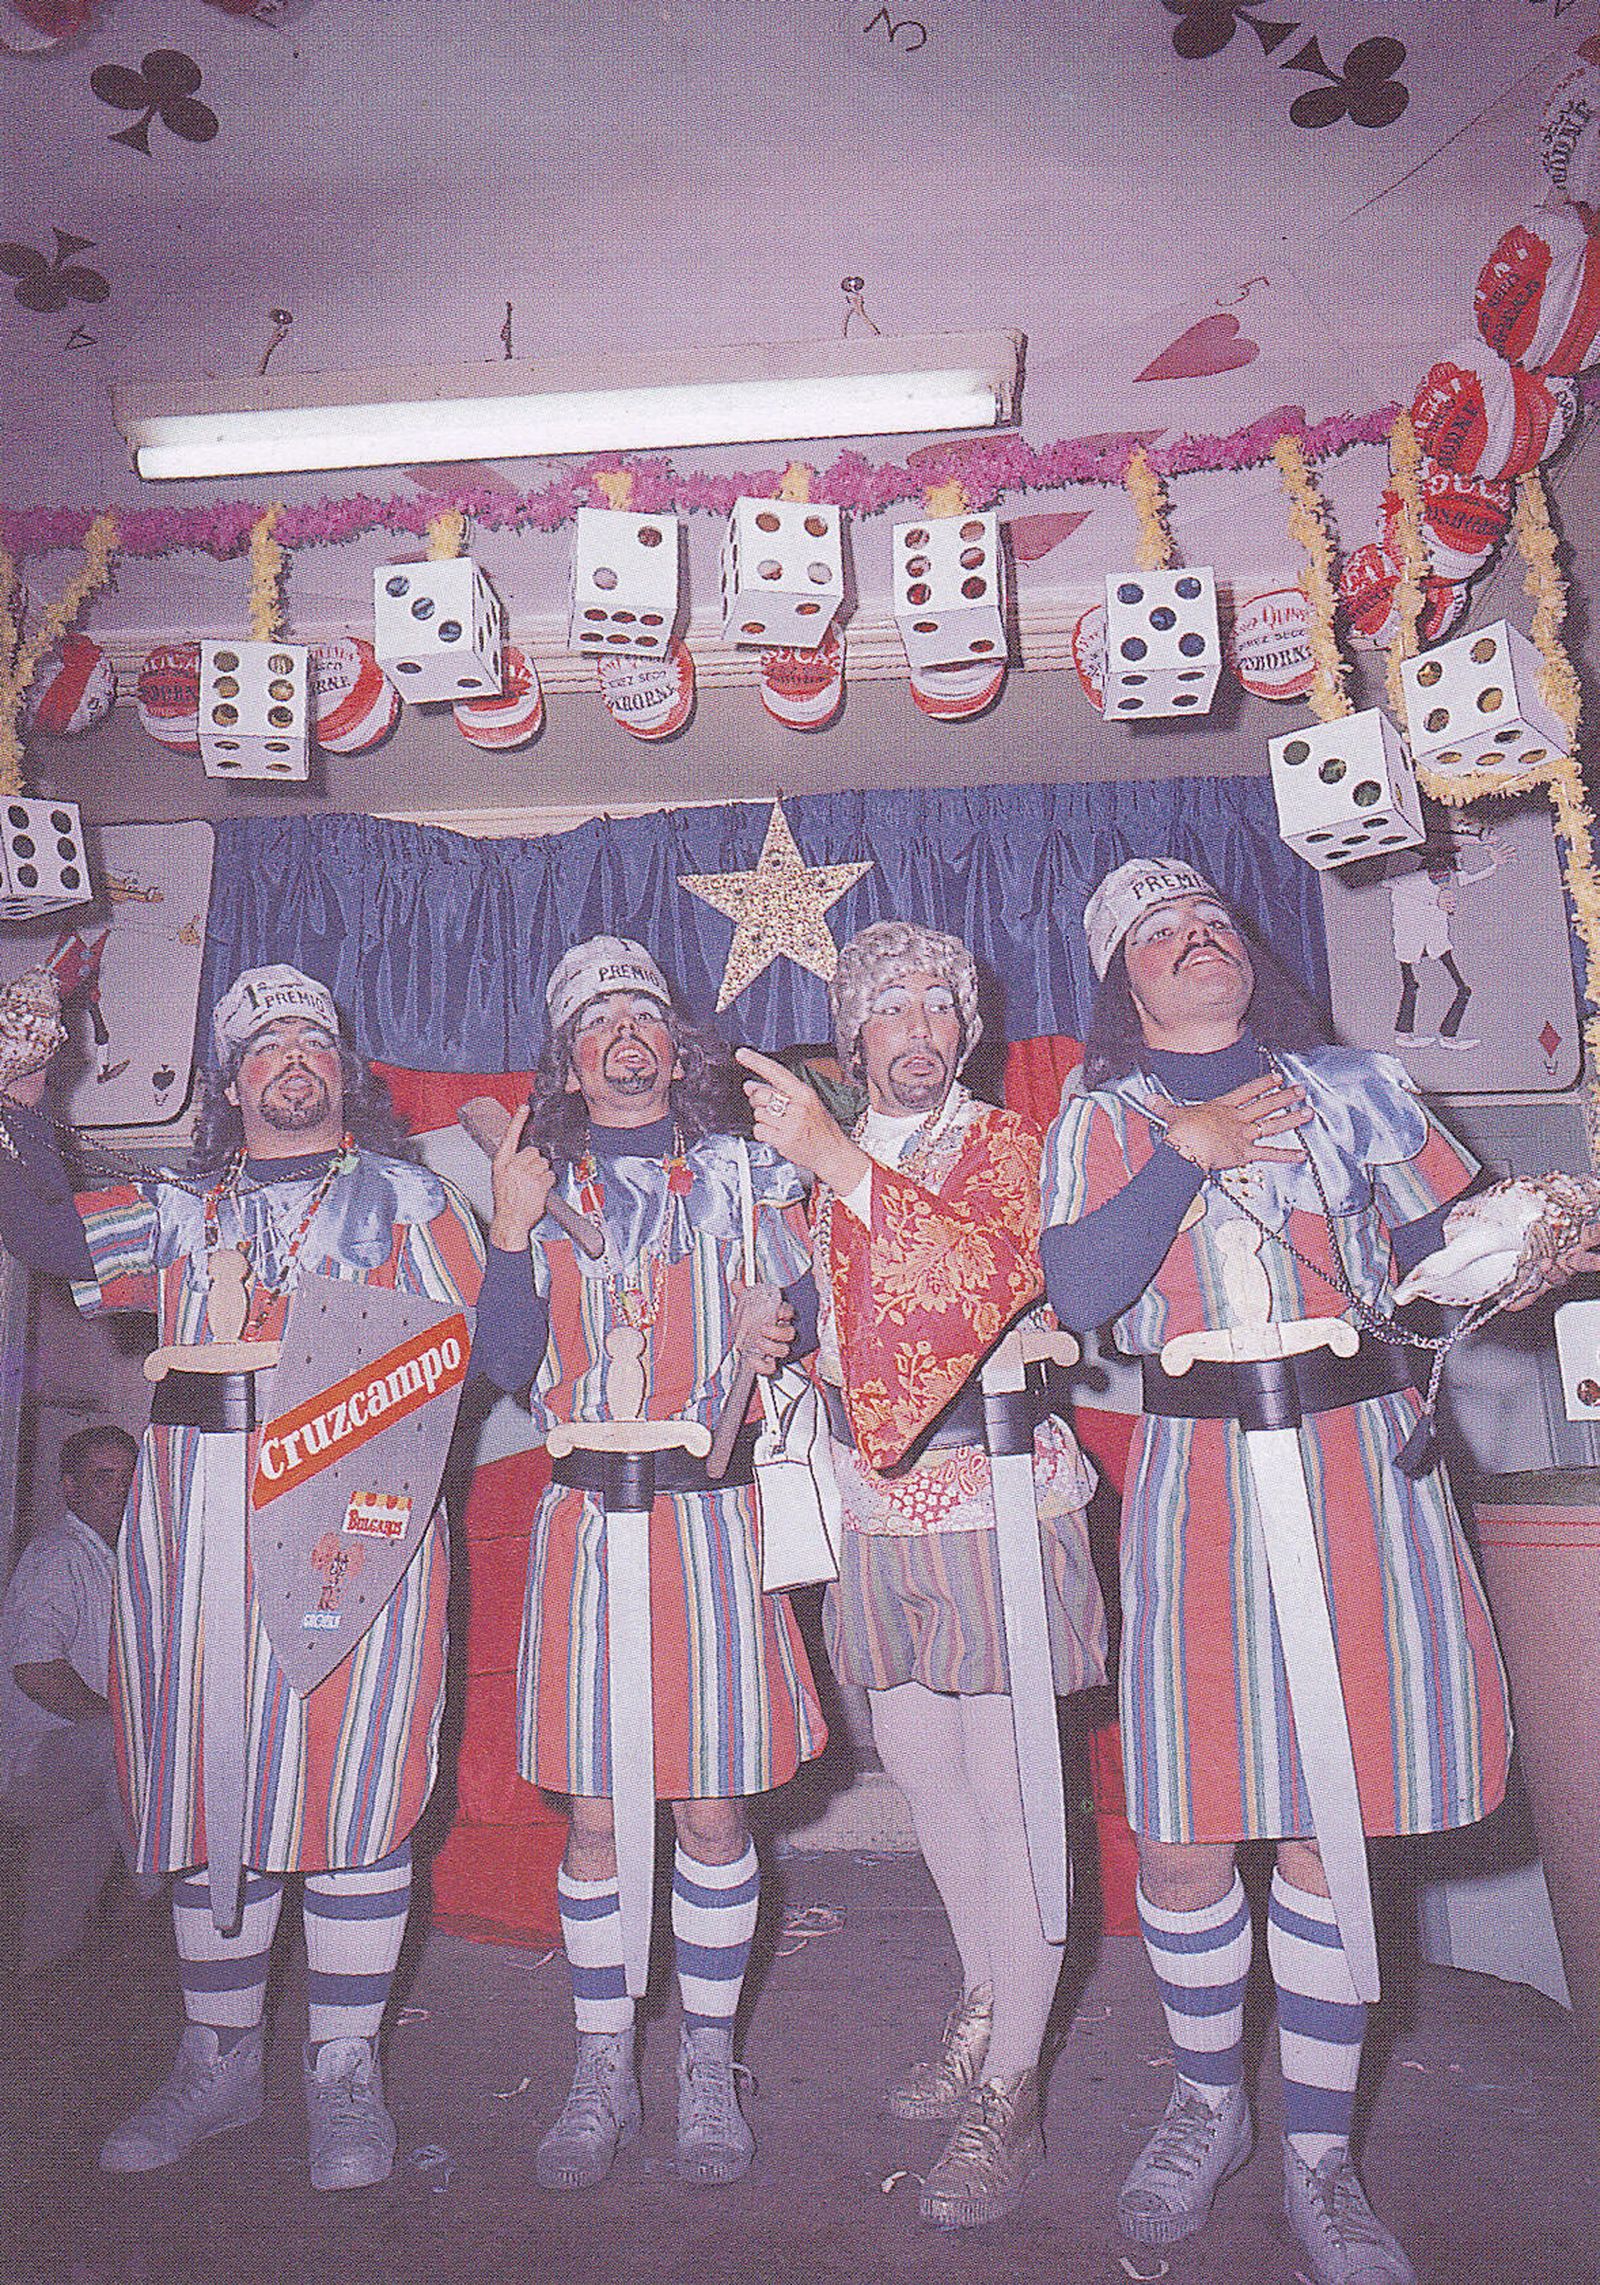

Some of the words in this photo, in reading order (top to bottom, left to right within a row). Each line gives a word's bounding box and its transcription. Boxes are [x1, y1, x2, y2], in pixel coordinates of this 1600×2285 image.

[1131, 872, 1206, 901] PREMI
[598, 963, 660, 988] PREMIO
[264, 989, 326, 1013] PREMIO
[259, 1336, 462, 1481] Cruzcampo
